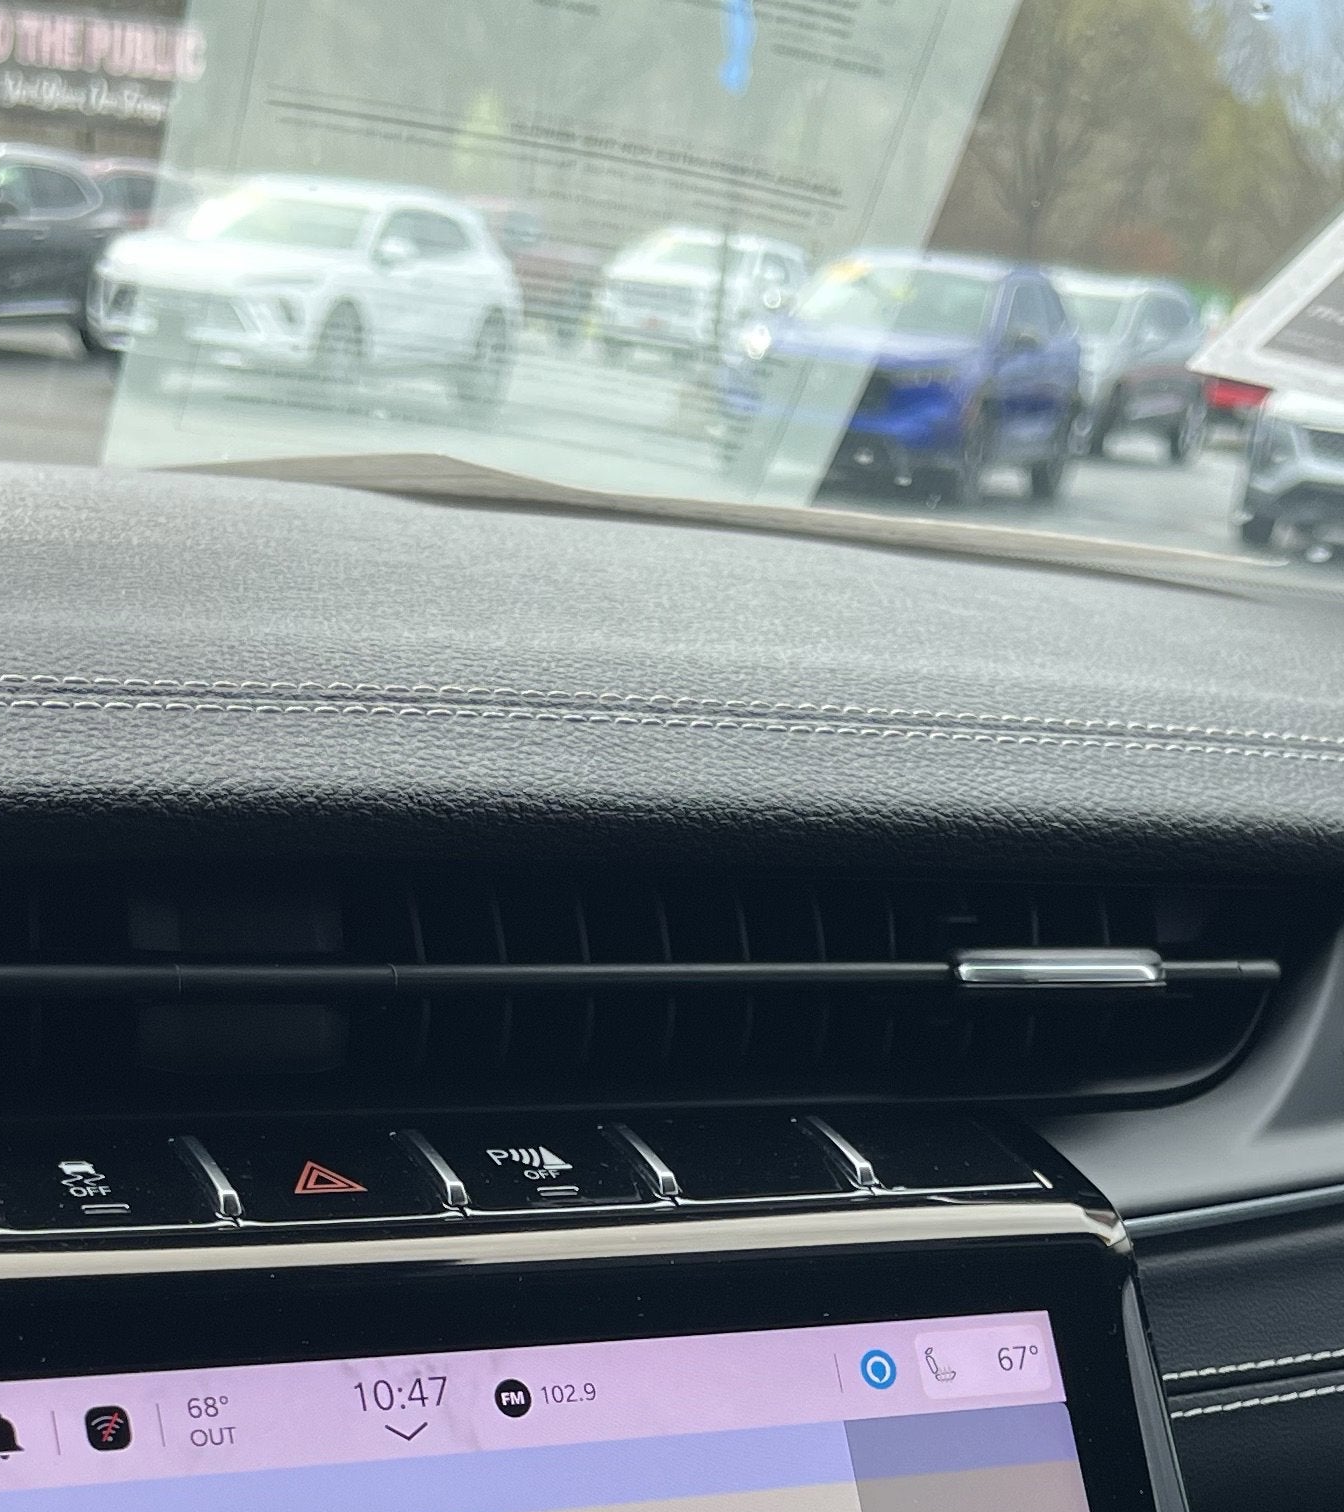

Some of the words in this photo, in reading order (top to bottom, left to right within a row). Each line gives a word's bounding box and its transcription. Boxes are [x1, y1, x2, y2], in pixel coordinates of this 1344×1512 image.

[14, 14, 82, 71] THE
[80, 18, 206, 82] PUBLIC
[523, 1169, 560, 1180] OFF
[69, 1185, 112, 1197] OFF
[997, 1344, 1039, 1373] 67°
[186, 1394, 230, 1420] 68°
[353, 1375, 449, 1414] 10:47
[500, 1390, 527, 1408] FM
[539, 1382, 598, 1406] 102.9
[189, 1425, 237, 1448] OUT
